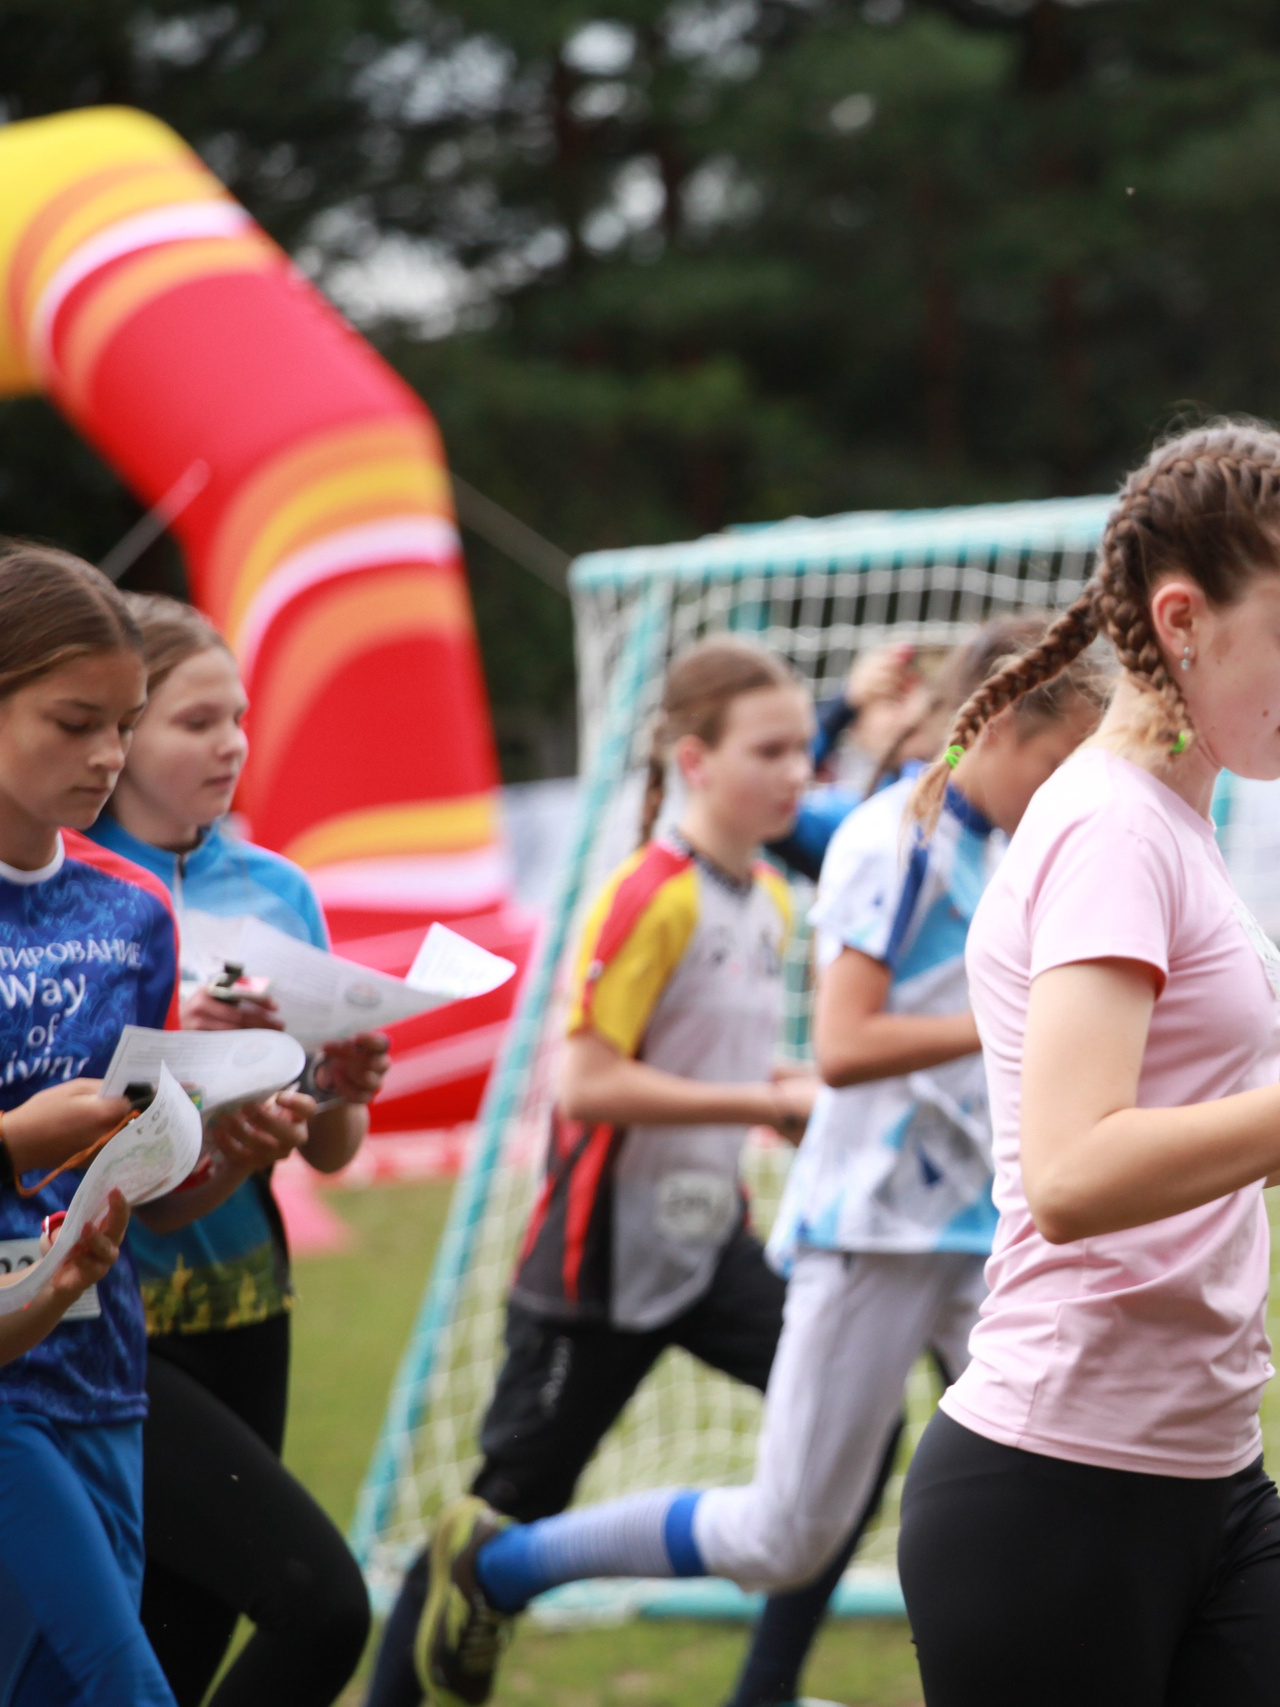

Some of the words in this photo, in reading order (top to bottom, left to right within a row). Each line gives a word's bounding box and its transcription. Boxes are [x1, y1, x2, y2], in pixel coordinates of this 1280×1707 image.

[0, 971, 86, 1018] Way
[28, 1013, 60, 1047] of
[0, 1049, 90, 1086] ivin
